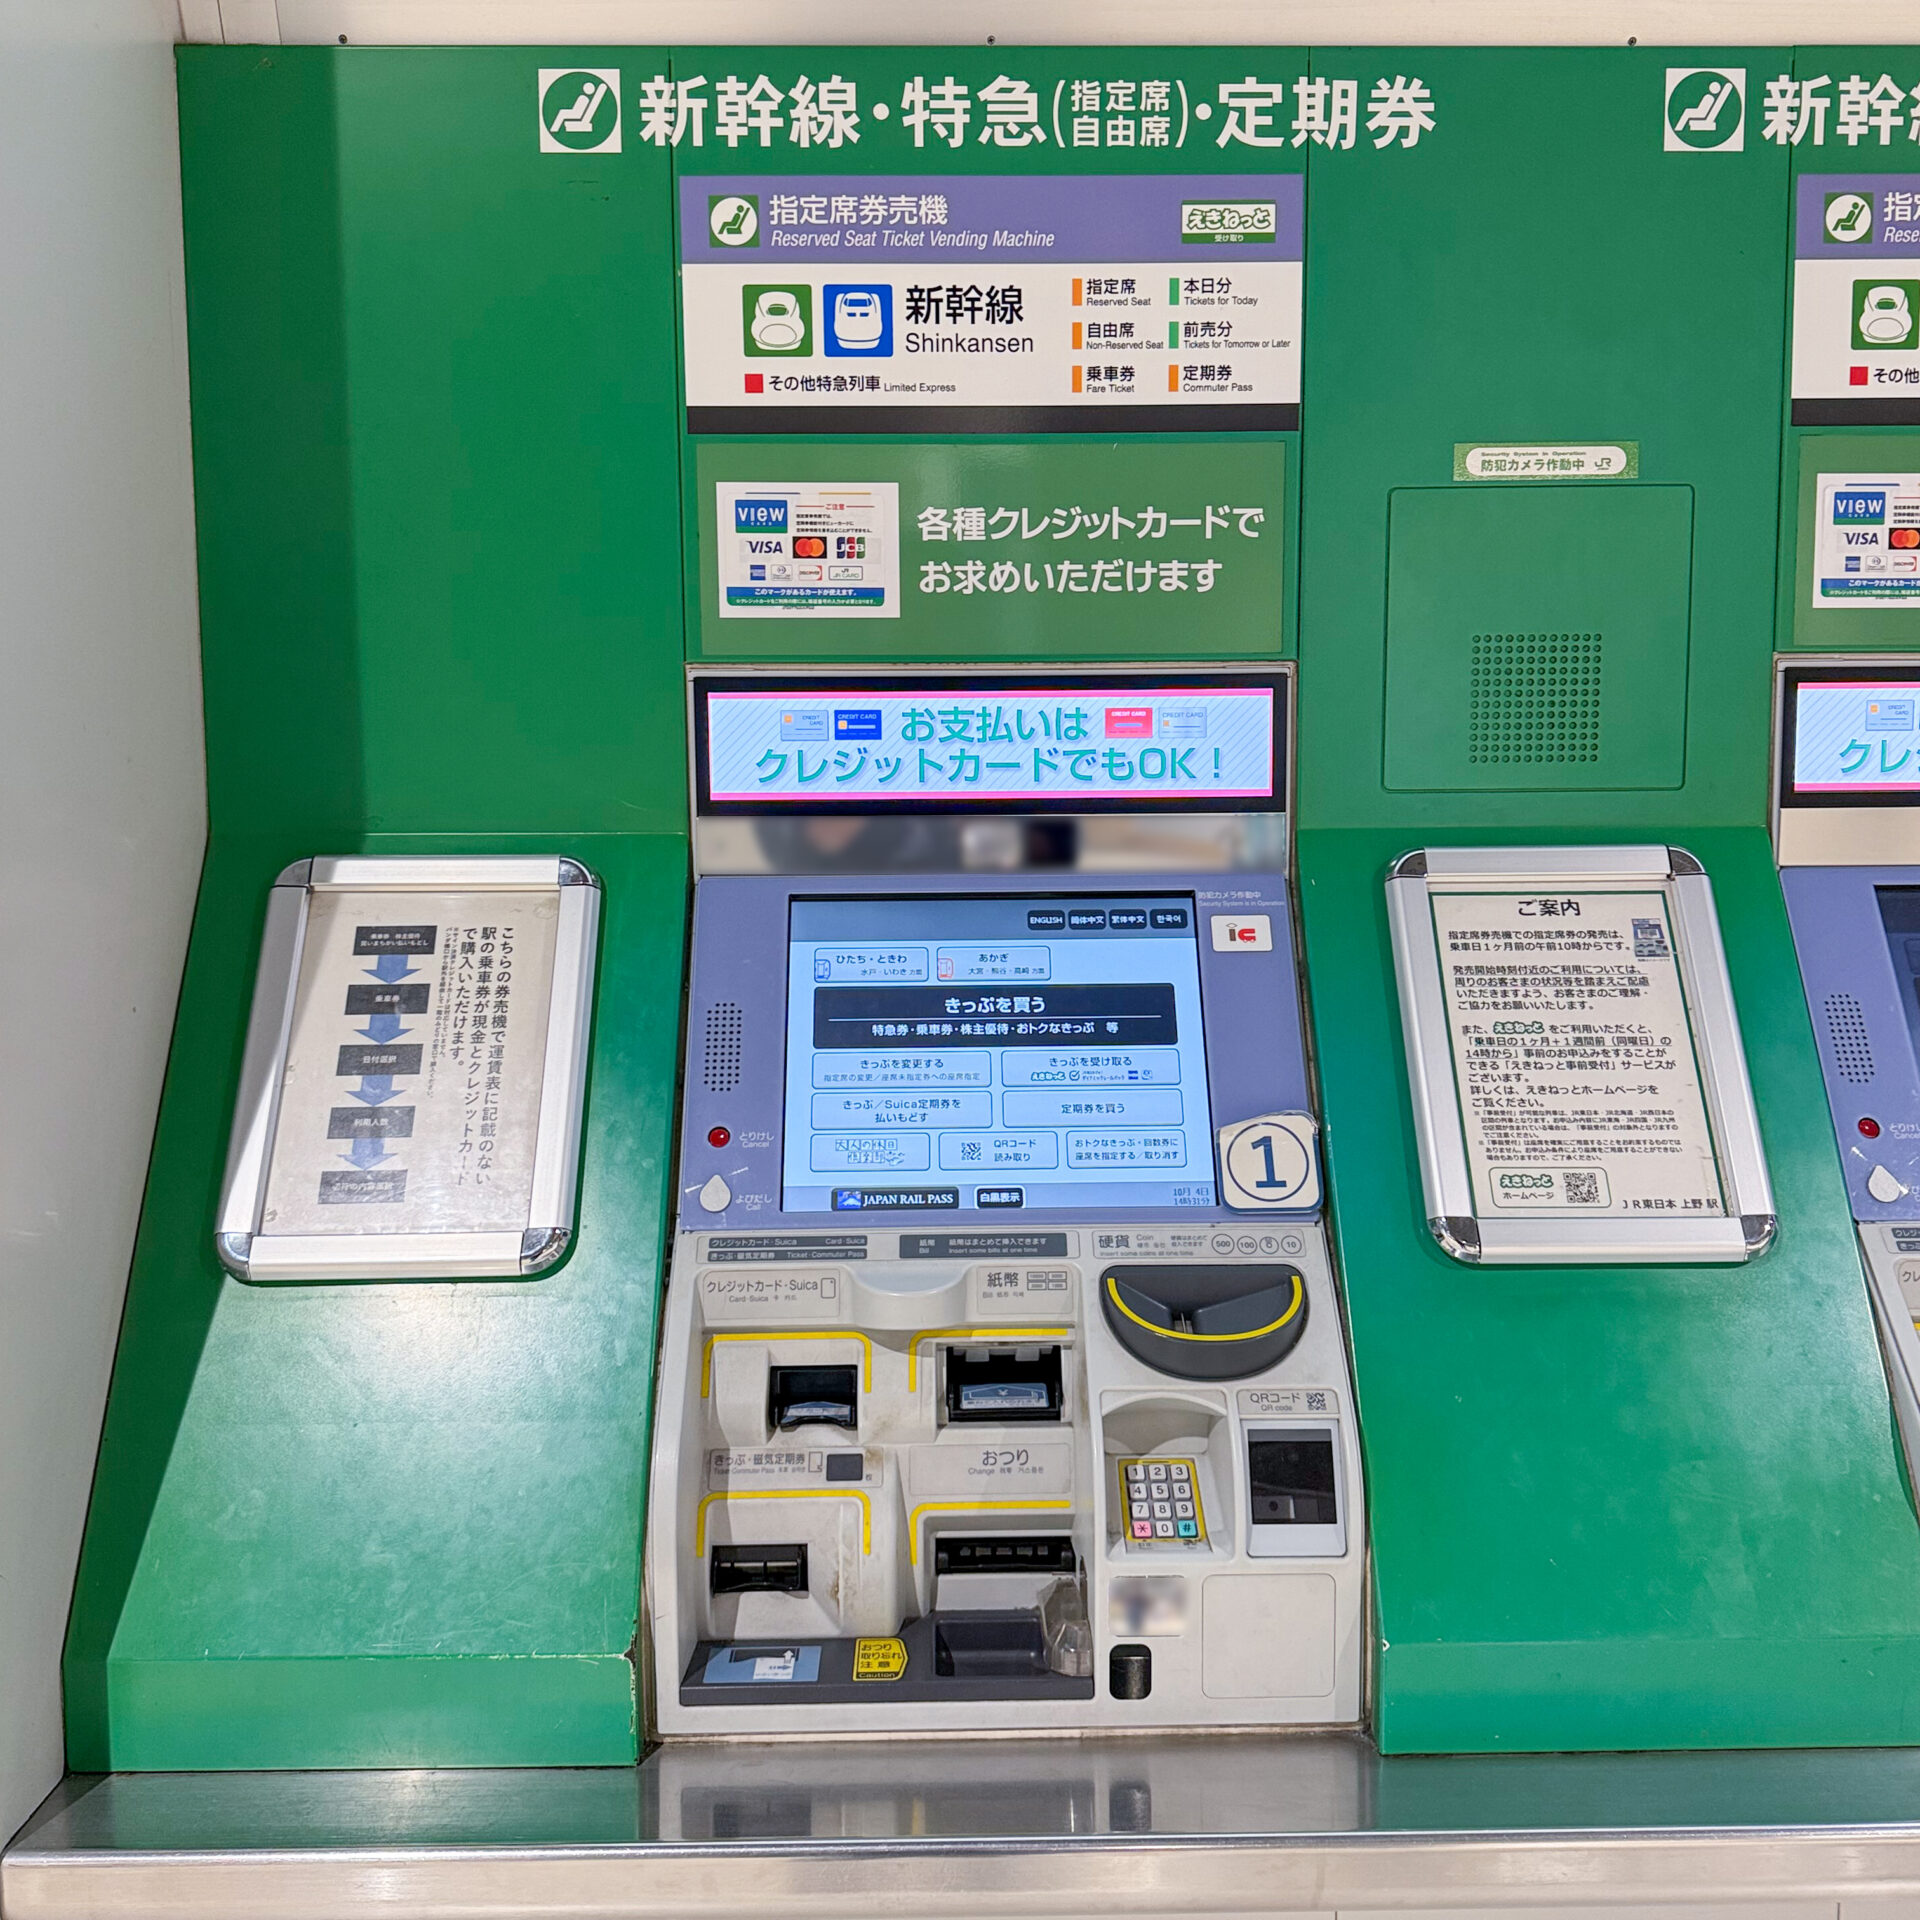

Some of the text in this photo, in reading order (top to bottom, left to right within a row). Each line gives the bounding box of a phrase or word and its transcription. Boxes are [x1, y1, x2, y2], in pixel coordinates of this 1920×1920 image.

[1070, 80, 1171, 112] 指定席
[1761, 73, 1920, 146] 新幹
[1071, 116, 1171, 148] 自由席
[769, 194, 949, 226] 指定席券売機
[1883, 191, 1920, 222] 指
[1187, 207, 1271, 231] えきねっと
[771, 230, 1055, 250] Reserved Seat Ticket Vending Machine
[1086, 278, 1136, 295] 指定席
[1184, 277, 1233, 294] 本日分
[905, 284, 1024, 325] 新幹線
[1086, 297, 1151, 306] Reserved Seat
[1184, 297, 1258, 307] Tickets for Today
[1087, 322, 1135, 338] 自由席
[1183, 321, 1233, 337] 前売分
[905, 333, 1034, 353] Shinkansen
[1086, 341, 1164, 349] Non-Reserved Seat
[1184, 340, 1210, 349] Tickets
[1212, 340, 1222, 349] for
[1224, 340, 1260, 348] Tomorrow
[1271, 340, 1291, 348] Later
[1086, 365, 1135, 382] 乗車券
[1183, 365, 1233, 381] 定期券
[768, 375, 881, 392] その他特急列車
[884, 382, 956, 394] Limited Express
[1087, 384, 1135, 393] Fare Ticket
[1183, 383, 1253, 392] Commuter Pass
[1481, 458, 1585, 472] 防犯カメラ作動中
[916, 505, 1266, 541] 各種クレジットカードで
[1843, 532, 1879, 545] VISA
[745, 541, 783, 554] VISA
[919, 558, 1223, 594] お求めいただけます
[901, 706, 1089, 743] お支払いは
[1839, 738, 1920, 773] クレ
[1518, 899, 1581, 917] ご案内
[1030, 916, 1063, 924] ENGLISH
[836, 955, 907, 964] ひたち・ときわ
[978, 953, 1009, 963] あかぎ
[945, 996, 1046, 1014] きっぷを買う
[1493, 1021, 1545, 1034] えきねっと
[860, 1058, 944, 1069] きっぷを変更する
[1049, 1056, 1132, 1066] きっぷを受け取る
[1468, 1073, 1531, 1083] ございます。
[1061, 1103, 1125, 1114] 定期券を買う
[1472, 1097, 1545, 1108] ご覧ください。
[875, 1112, 928, 1123] 払いもどす
[739, 1132, 774, 1141] とりけし
[994, 1139, 1036, 1148] QRコード
[1251, 1135, 1287, 1188] 1
[1500, 1173, 1553, 1188] えきねっと
[863, 1193, 953, 1206] JAPAN RAIL PASS
[1502, 1191, 1554, 1200] ホームページ
[1098, 1235, 1130, 1248] 硬貨
[987, 1272, 1019, 1288] 紙幣
[1250, 1392, 1301, 1403] QRコード
[982, 1449, 1029, 1466] おつり
[968, 1467, 995, 1476] Change
[860, 1652, 902, 1660] 取り忘れ
